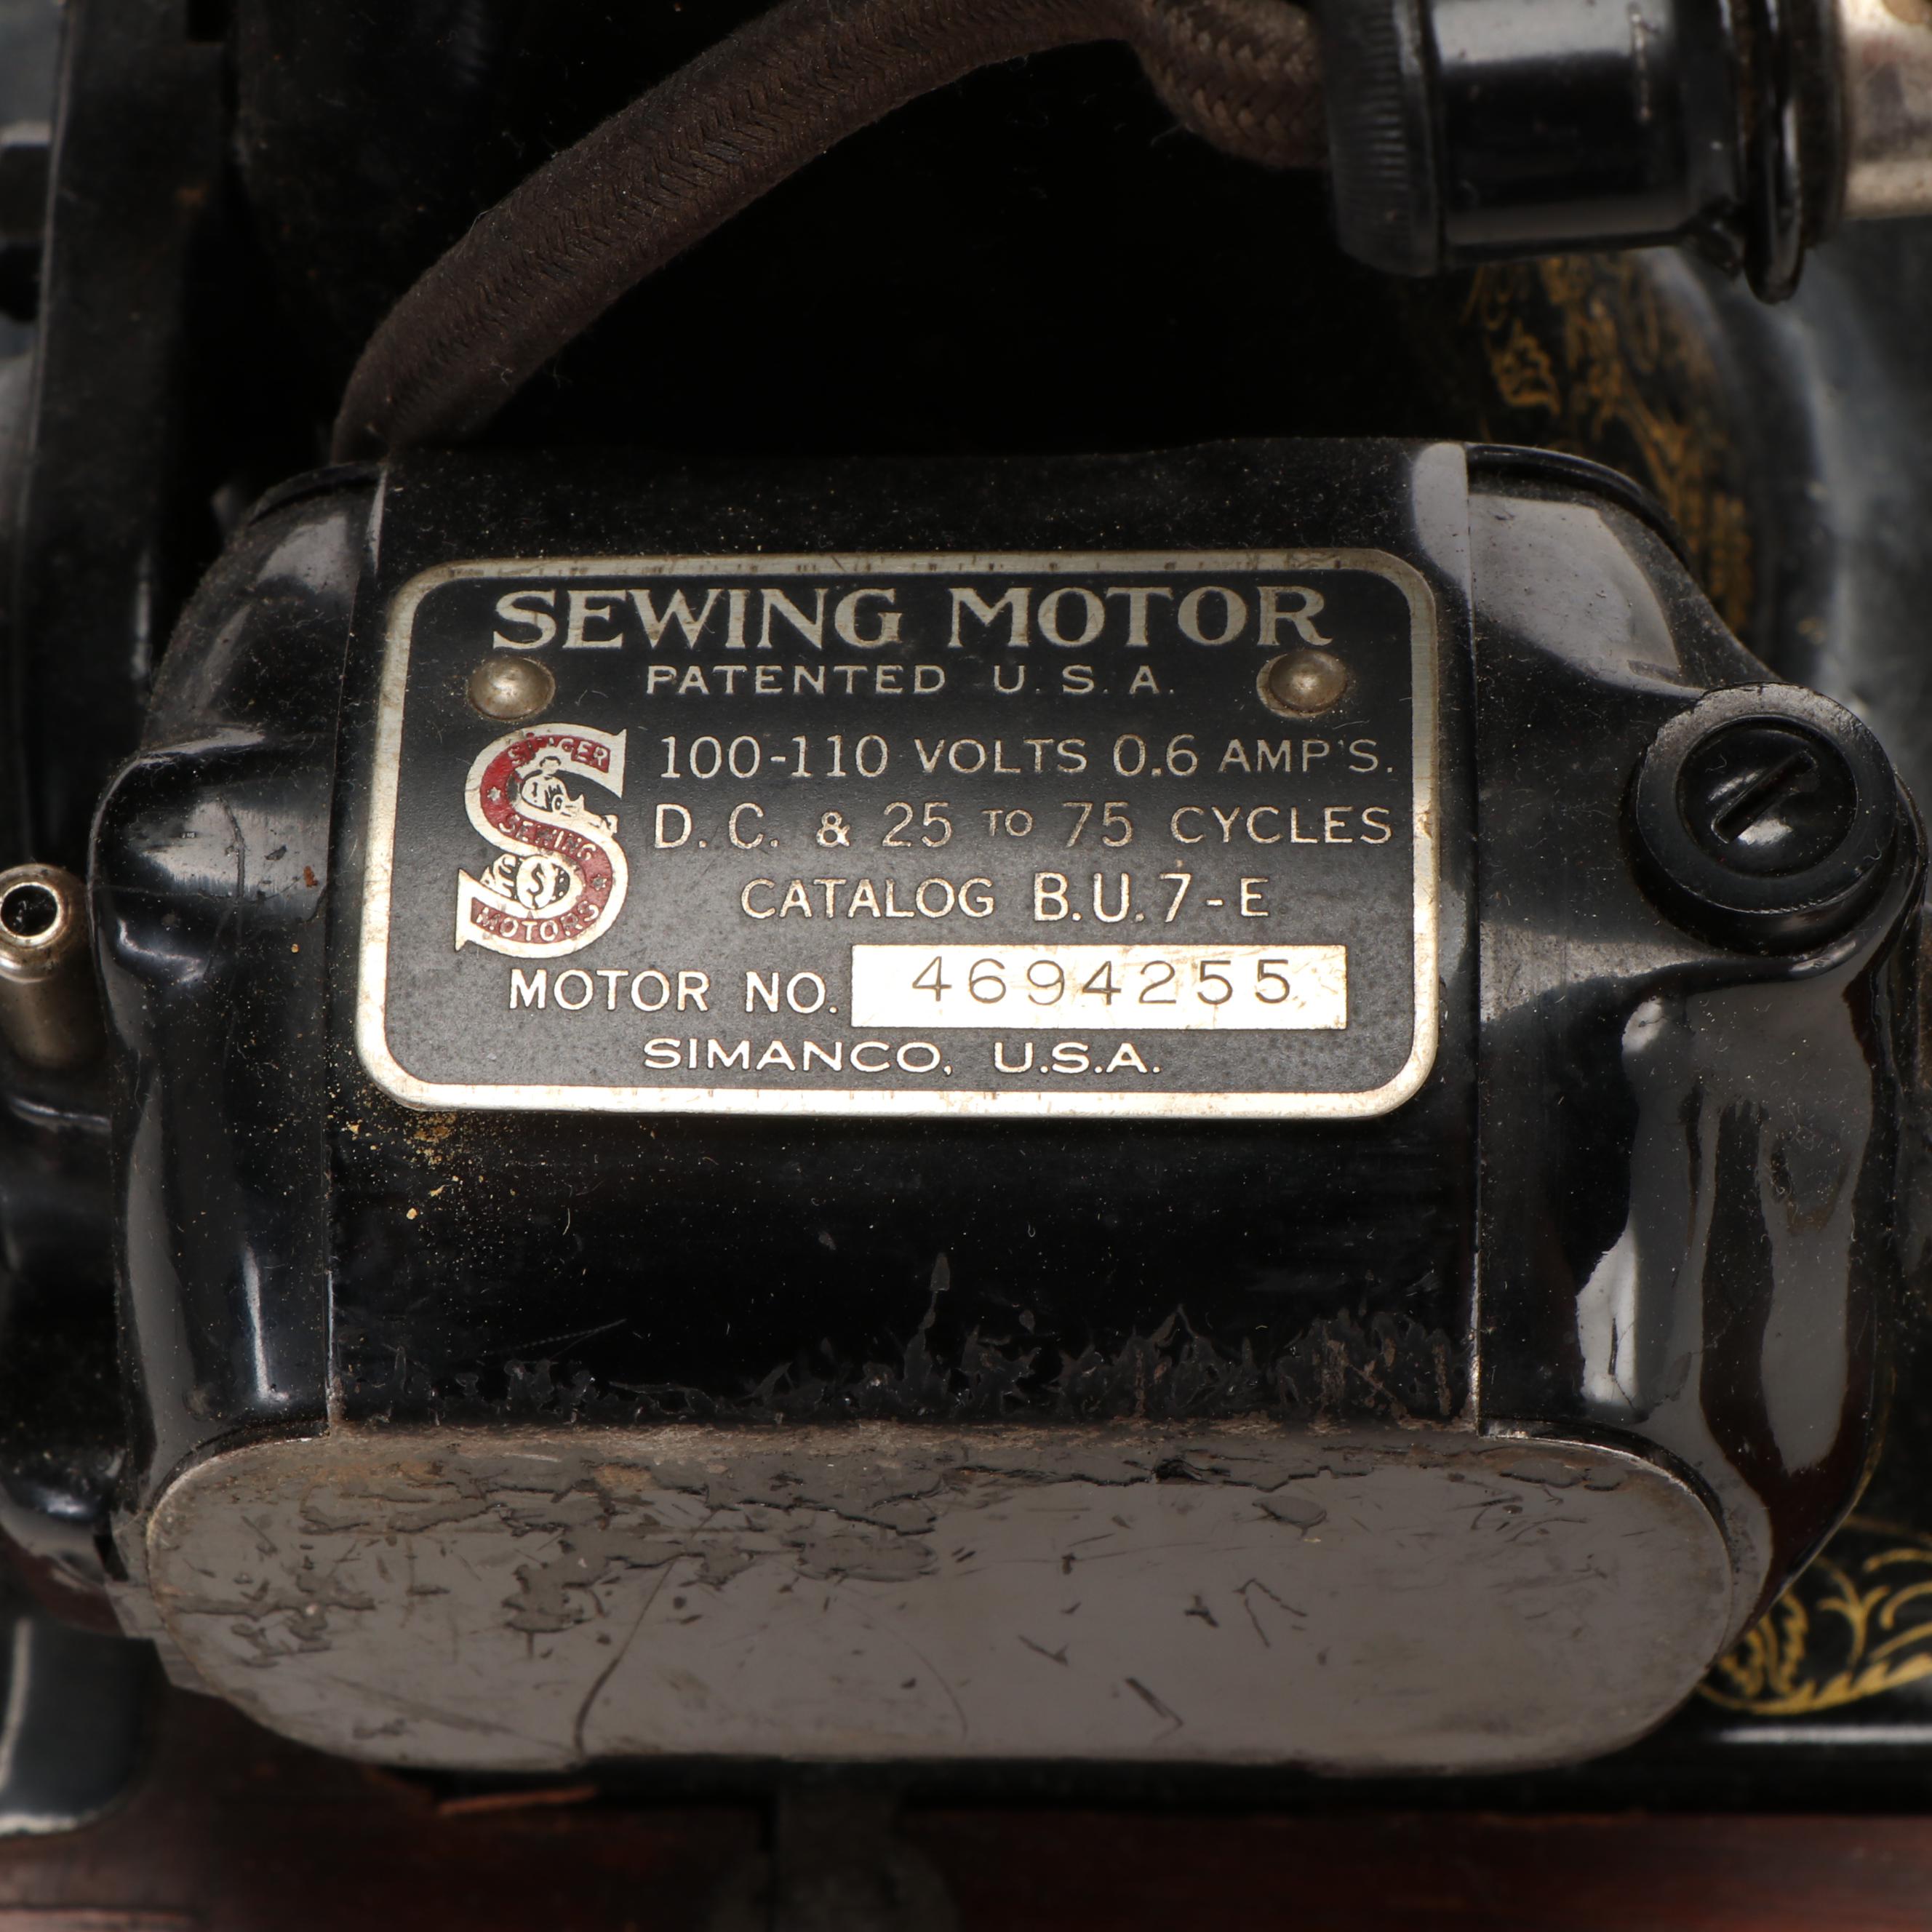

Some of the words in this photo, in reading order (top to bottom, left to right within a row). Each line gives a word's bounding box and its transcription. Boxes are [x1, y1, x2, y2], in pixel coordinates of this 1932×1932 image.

[492, 587, 903, 650] SEWING
[947, 586, 1333, 648] MOTOR
[646, 665, 946, 695] PATENTED
[660, 735, 888, 780] 100-110
[914, 738, 1087, 774] VOLTS
[1113, 734, 1198, 778] 0.6
[816, 812, 850, 848] &
[882, 802, 952, 848] 25
[981, 809, 1033, 837] TO
[1063, 802, 1133, 848] 75
[1170, 807, 1392, 845] CYCLES
[477, 901, 599, 941] MOTORS
[741, 878, 994, 919] CATALOG
[509, 969, 709, 1012] MOTOR
[746, 970, 837, 1014] NO.
[911, 956, 1291, 1005] 4694255
